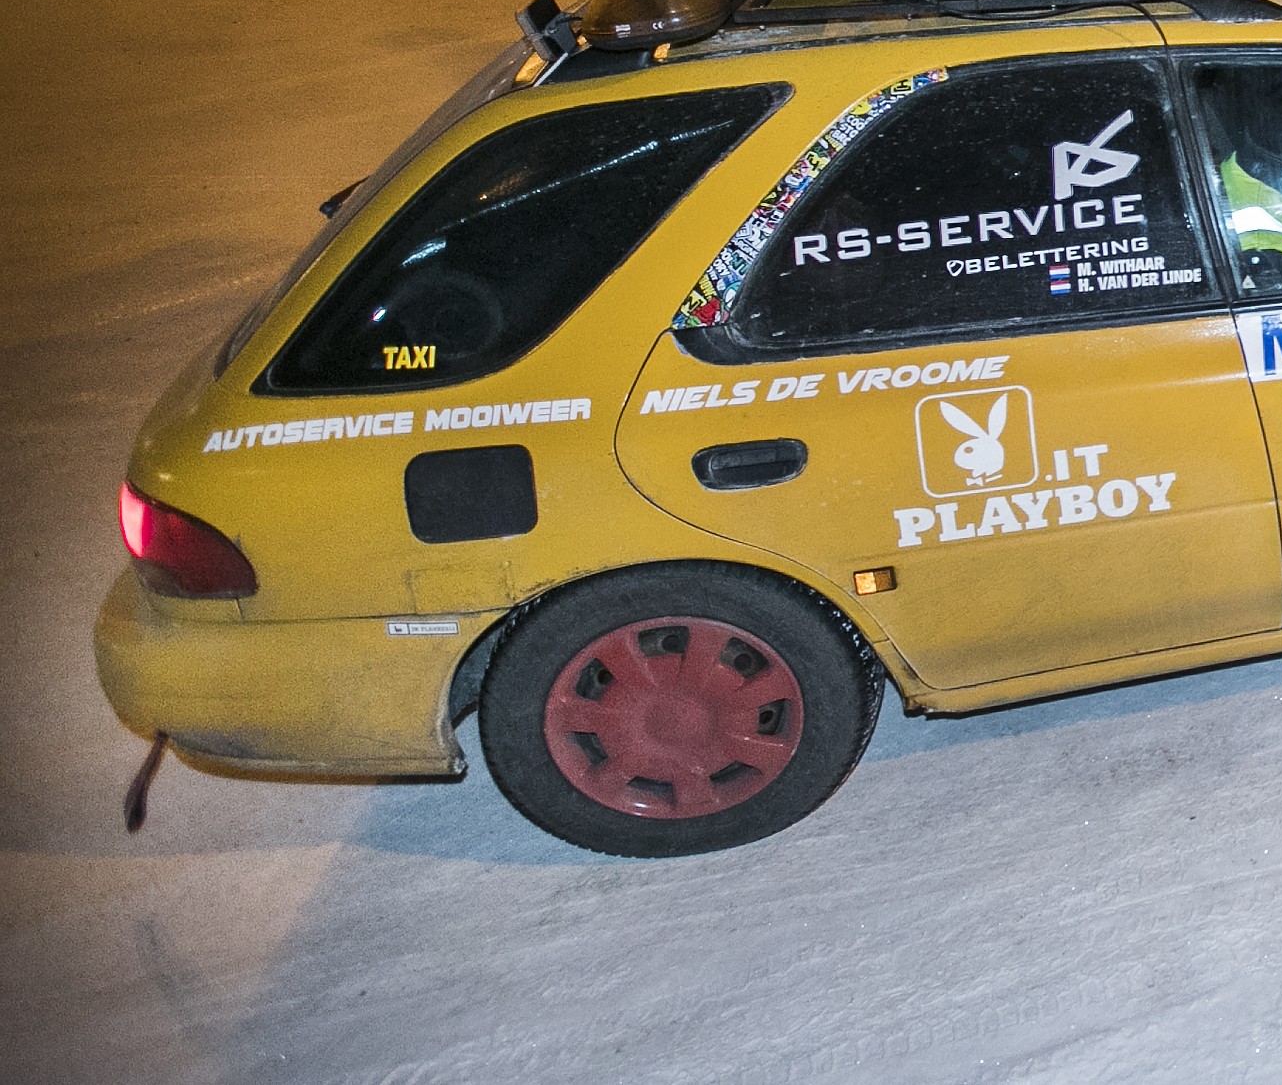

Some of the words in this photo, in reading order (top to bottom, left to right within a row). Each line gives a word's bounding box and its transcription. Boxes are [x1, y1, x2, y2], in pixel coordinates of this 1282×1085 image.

[793, 194, 1146, 266] RS-SERVICE
[965, 236, 1150, 276] BELETTERING
[1076, 261, 1097, 277] M.
[1099, 256, 1166, 275] WITHAAR
[1077, 278, 1095, 293] H.
[1097, 274, 1130, 292] VAN
[1130, 272, 1160, 288] DER
[1161, 267, 1202, 285] LINDE
[382, 345, 437, 371] TAXI
[639, 377, 762, 415] NIELS
[765, 373, 827, 402] DE
[837, 354, 1011, 395] VROOME
[202, 410, 415, 454] AUTOSERVICE
[423, 397, 592, 432] MOOIWEER
[893, 472, 1178, 549] PLAYBOY
